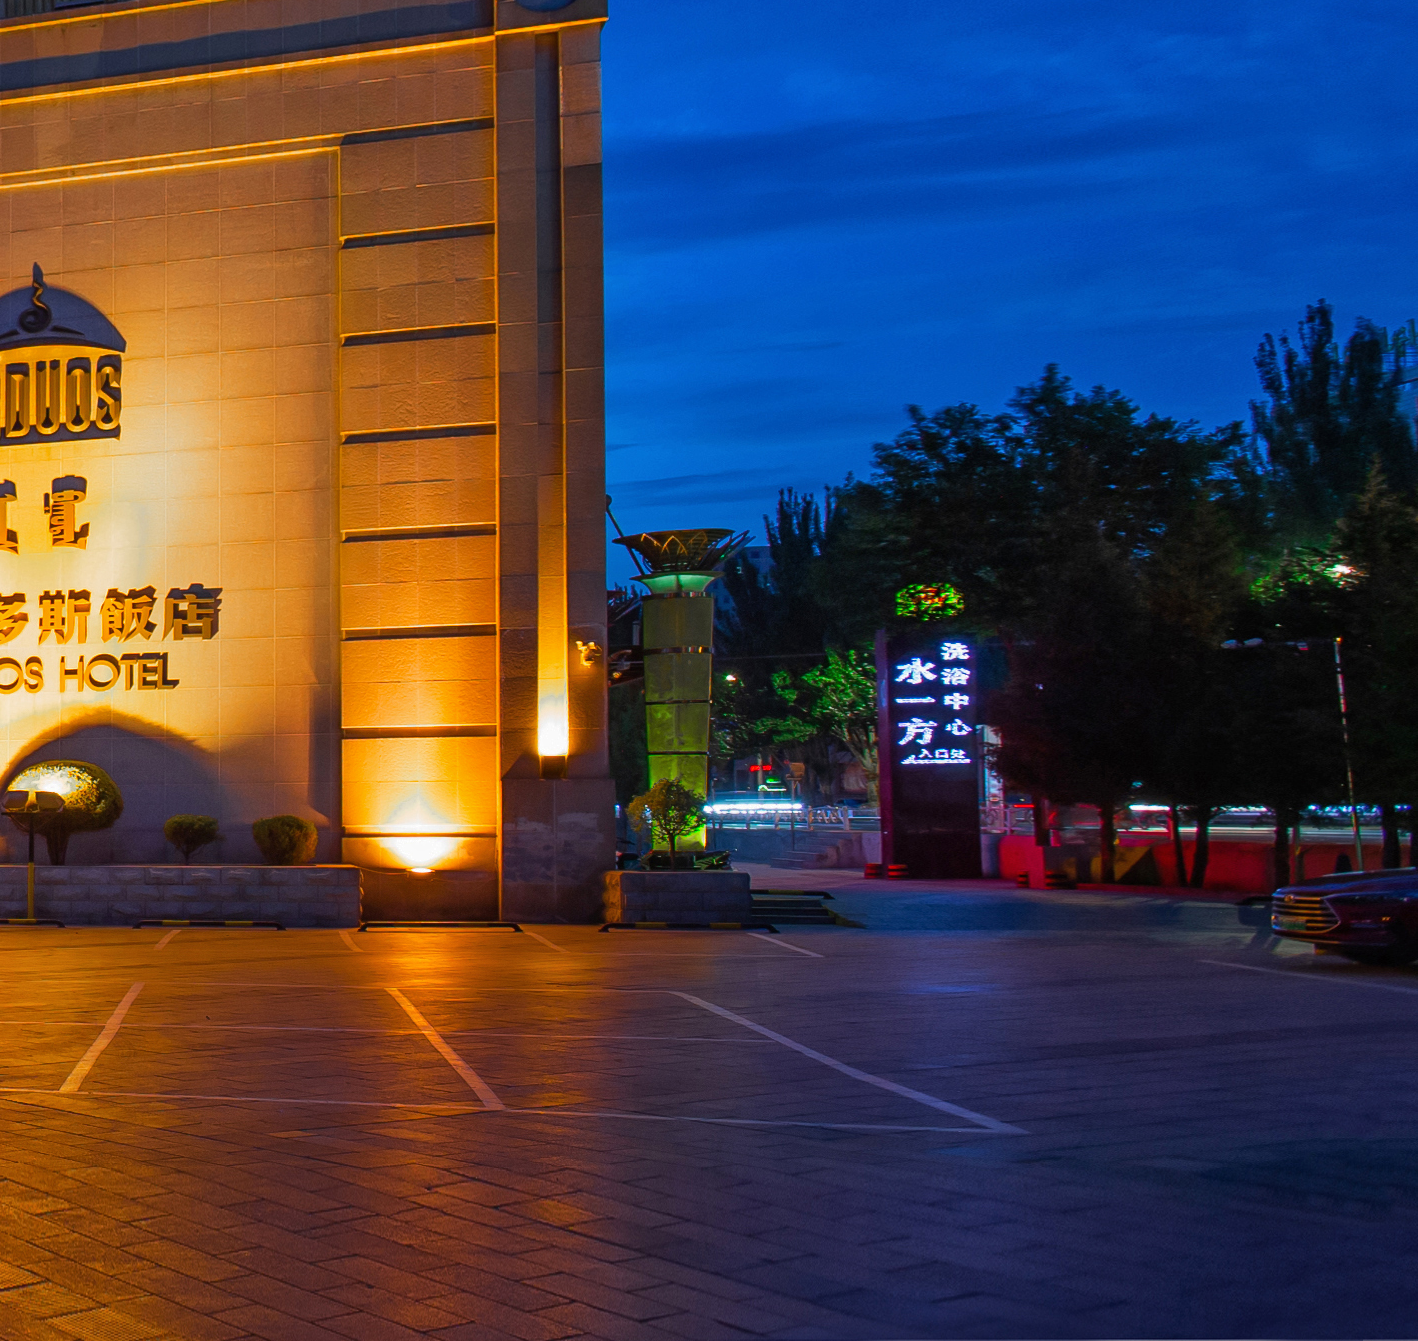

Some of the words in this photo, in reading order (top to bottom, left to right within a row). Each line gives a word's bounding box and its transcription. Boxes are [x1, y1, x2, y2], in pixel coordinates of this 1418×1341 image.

[60, 652, 180, 693] HOTEL
[894, 657, 937, 745] 水一方
[940, 642, 973, 736] 洗浴中心
[918, 748, 966, 759] 入口处
